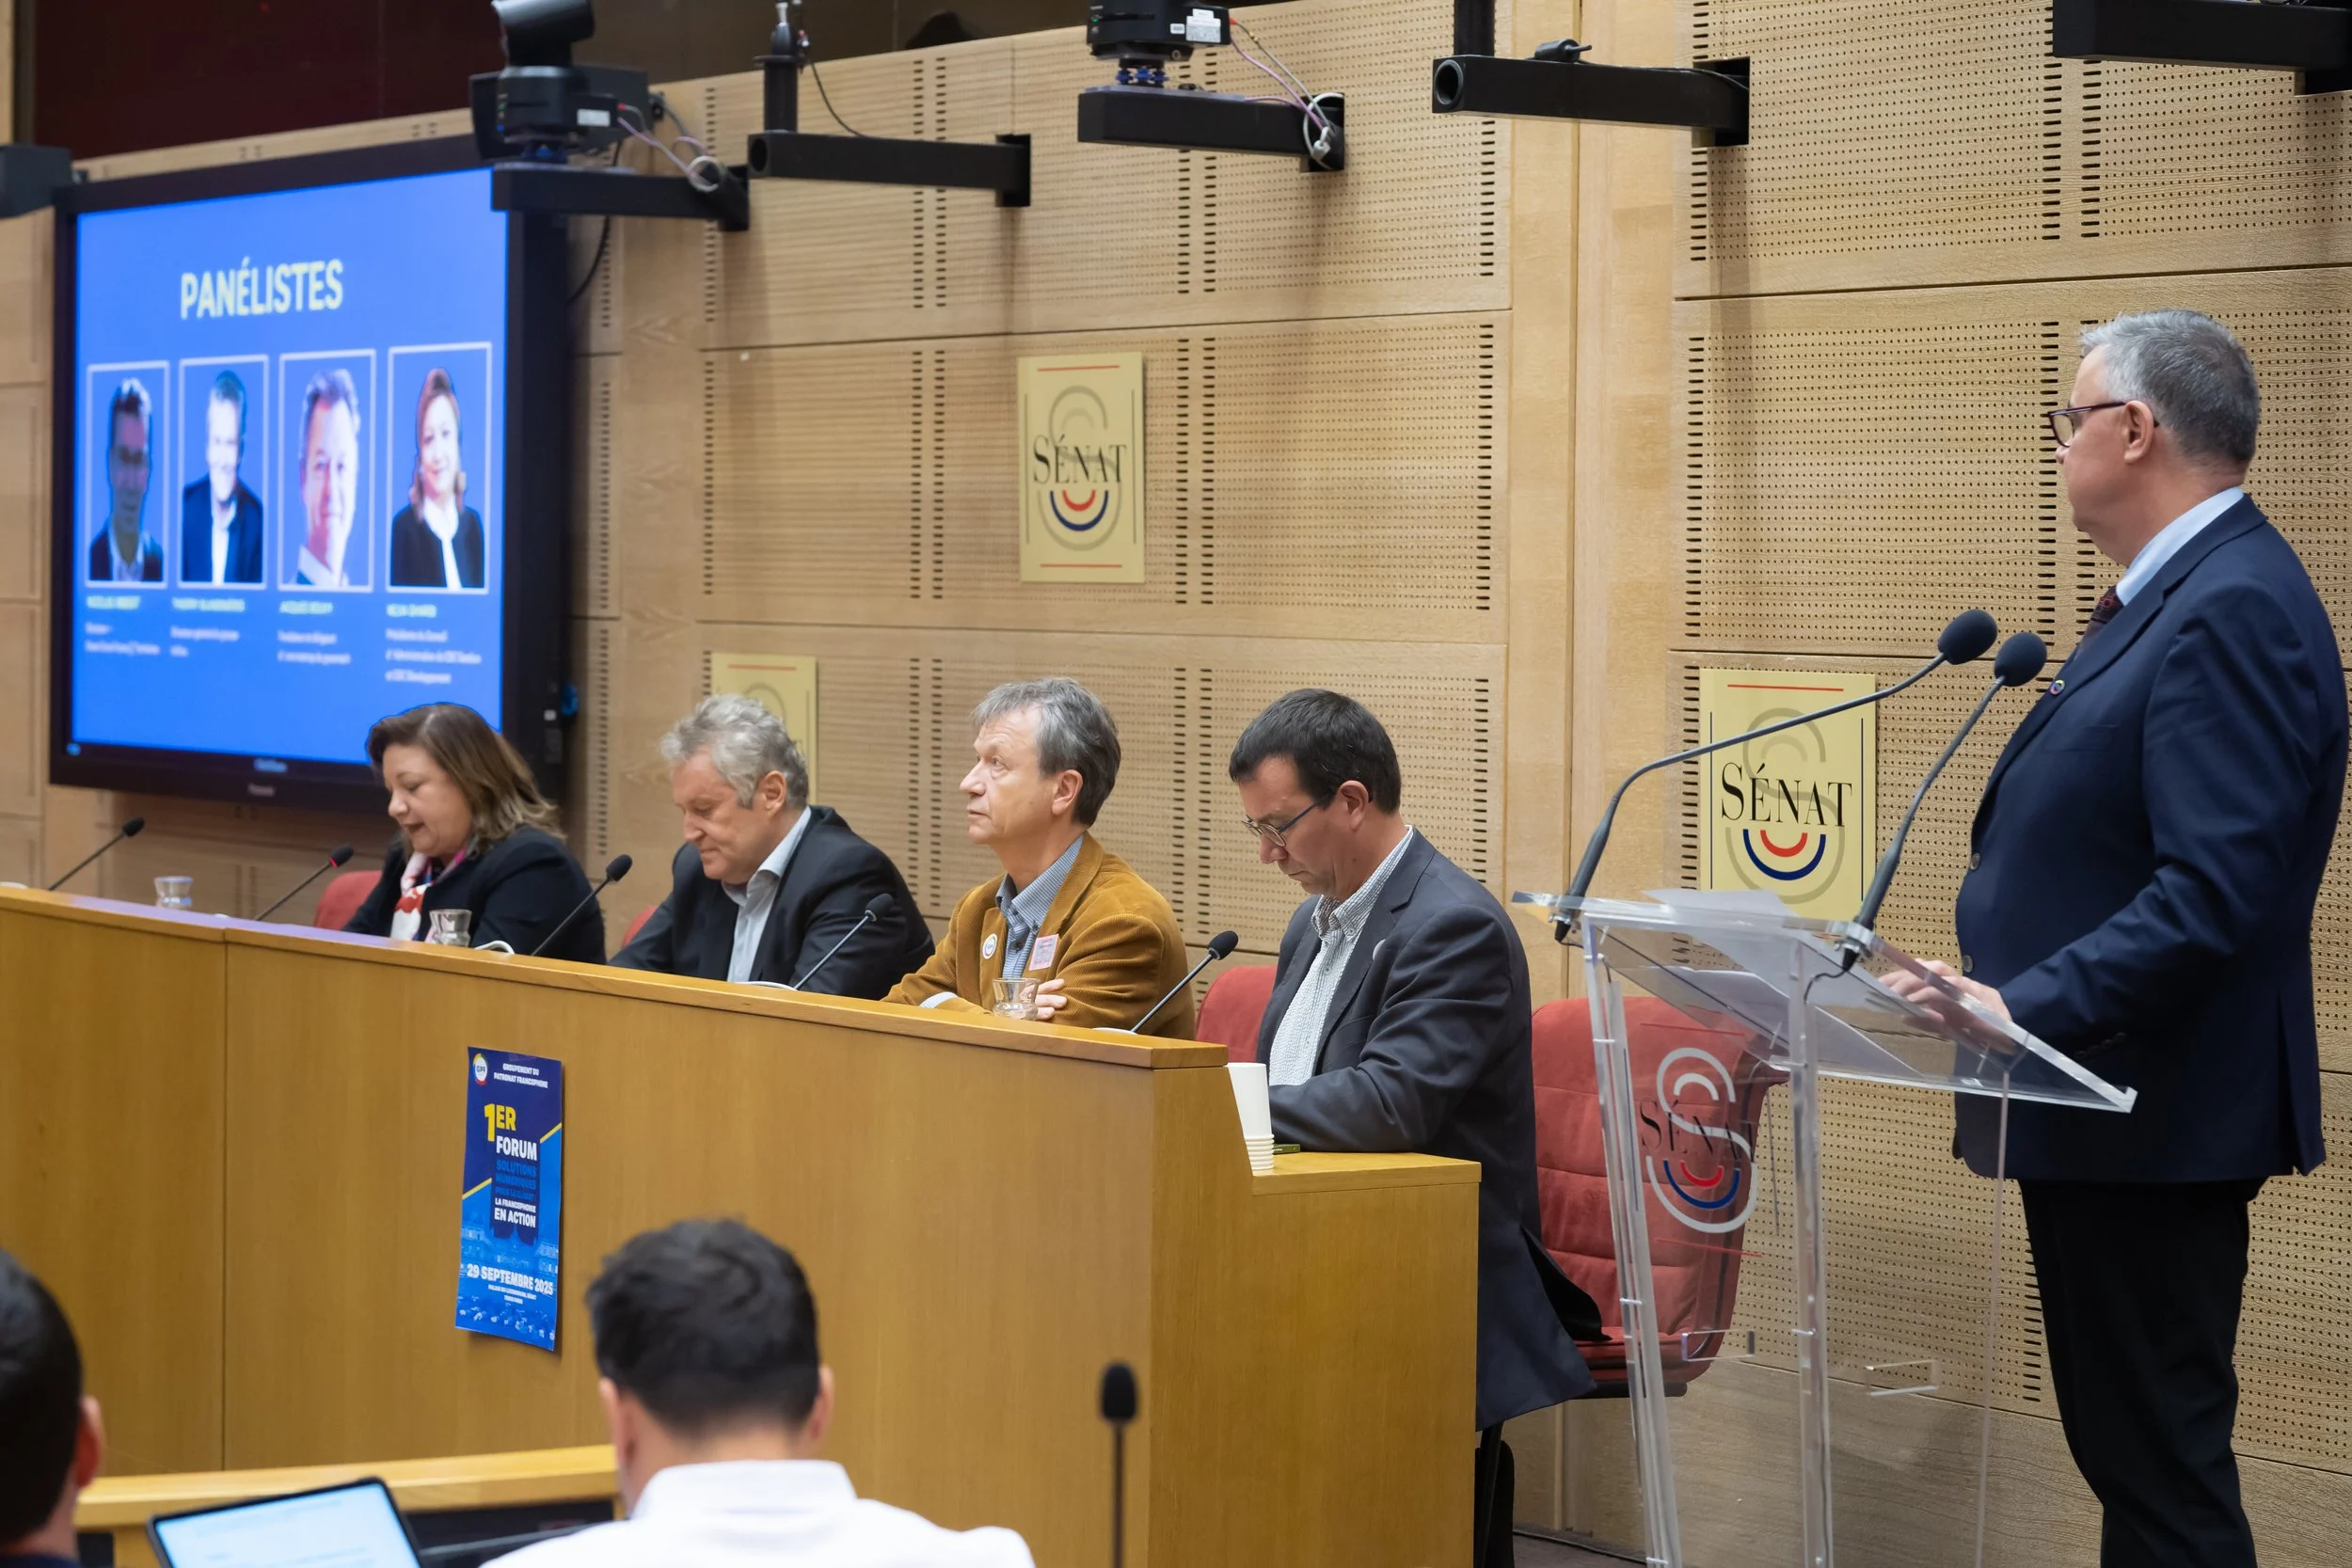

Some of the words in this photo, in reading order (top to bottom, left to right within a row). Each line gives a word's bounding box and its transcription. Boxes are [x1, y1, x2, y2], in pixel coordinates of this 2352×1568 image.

[181, 255, 344, 320] PANÉLISTES
[1033, 434, 1127, 484] SÉNAT
[1722, 762, 1852, 827] SÉNAT
[1640, 1097, 1756, 1163] SÉNAT
[496, 1135, 538, 1161] FORUM
[496, 1159, 537, 1177] SOLUTIONS
[494, 1196, 502, 1206] LA
[494, 1207, 507, 1221] EN
[507, 1210, 536, 1228] ACTION
[467, 1263, 480, 1278] 29
[481, 1266, 533, 1291] SEPTEMBRE
[533, 1278, 553, 1295] 2025
